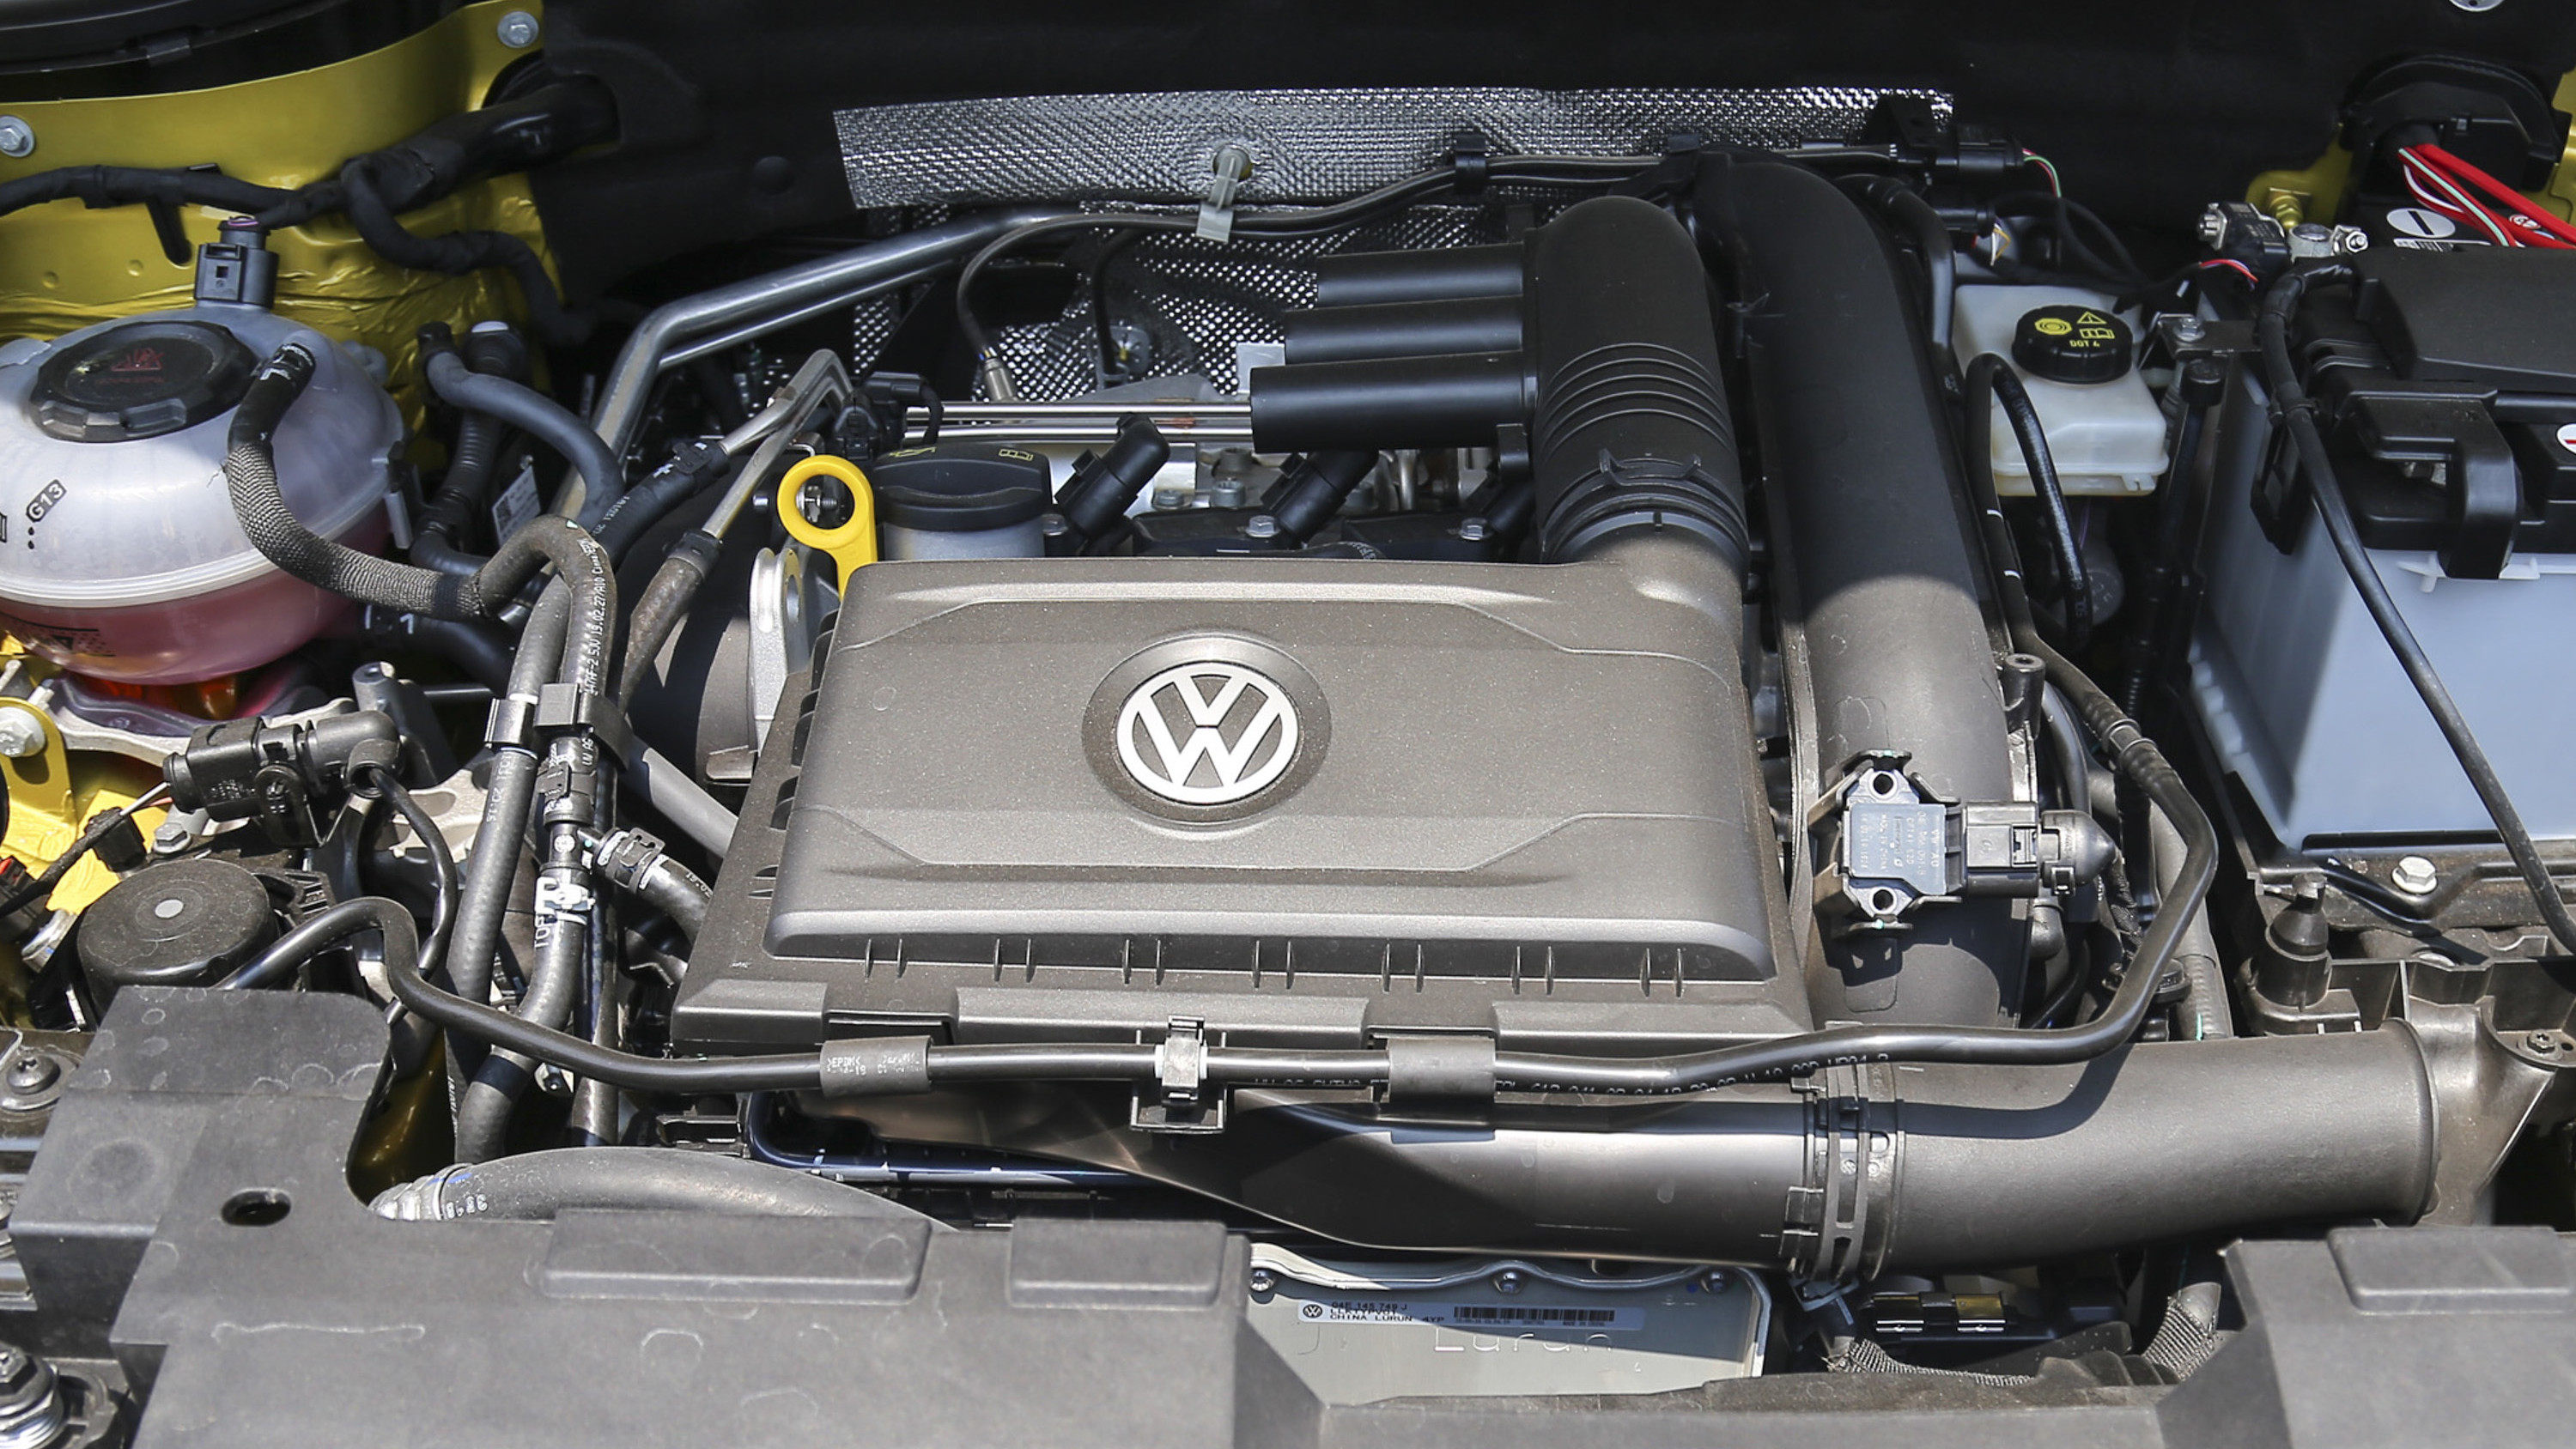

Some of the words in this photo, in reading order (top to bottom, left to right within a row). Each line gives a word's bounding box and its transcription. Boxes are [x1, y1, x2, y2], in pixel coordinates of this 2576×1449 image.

[2069, 339, 2090, 348] DOT
[27, 482, 64, 519] G13
[534, 915, 555, 949] TOP
